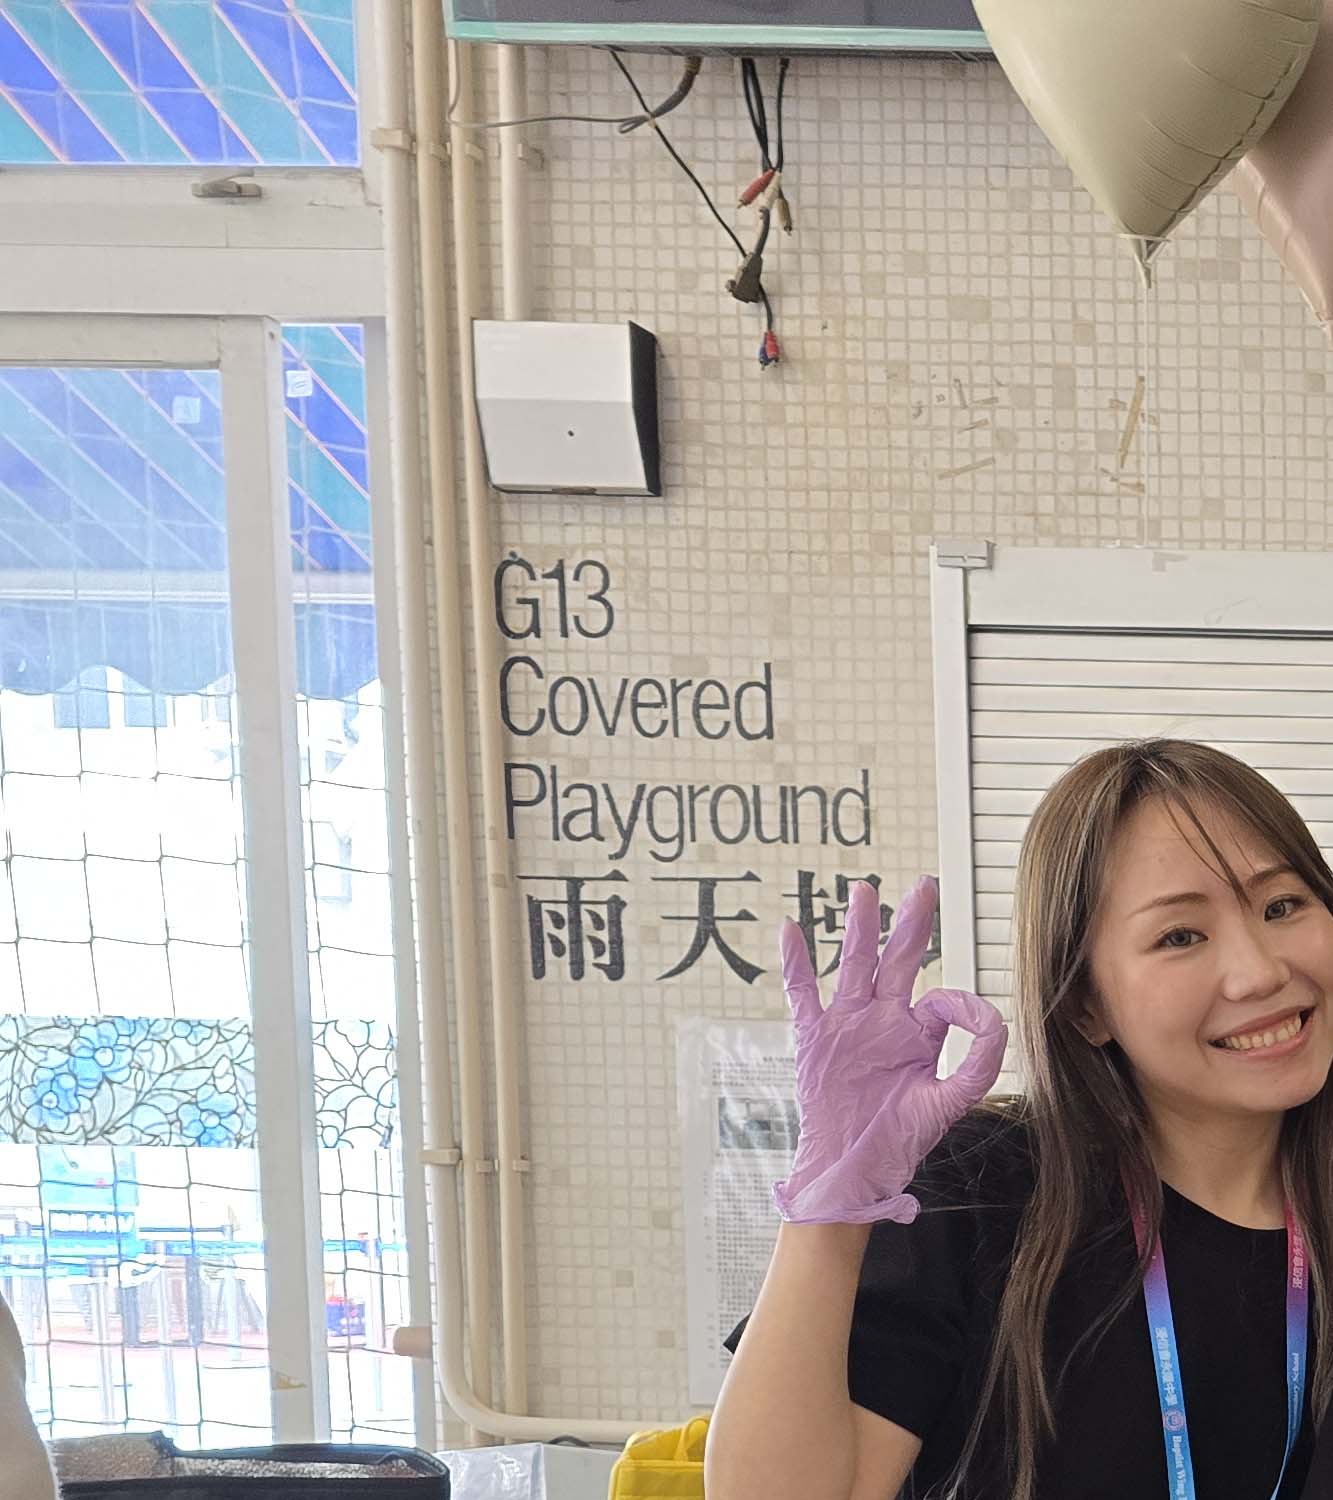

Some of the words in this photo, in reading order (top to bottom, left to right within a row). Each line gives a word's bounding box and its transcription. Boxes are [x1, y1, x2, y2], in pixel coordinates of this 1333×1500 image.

[493, 557, 615, 639] G13
[500, 656, 774, 741] Covered
[503, 762, 871, 861] Playground
[516, 868, 941, 984] 雨天操
